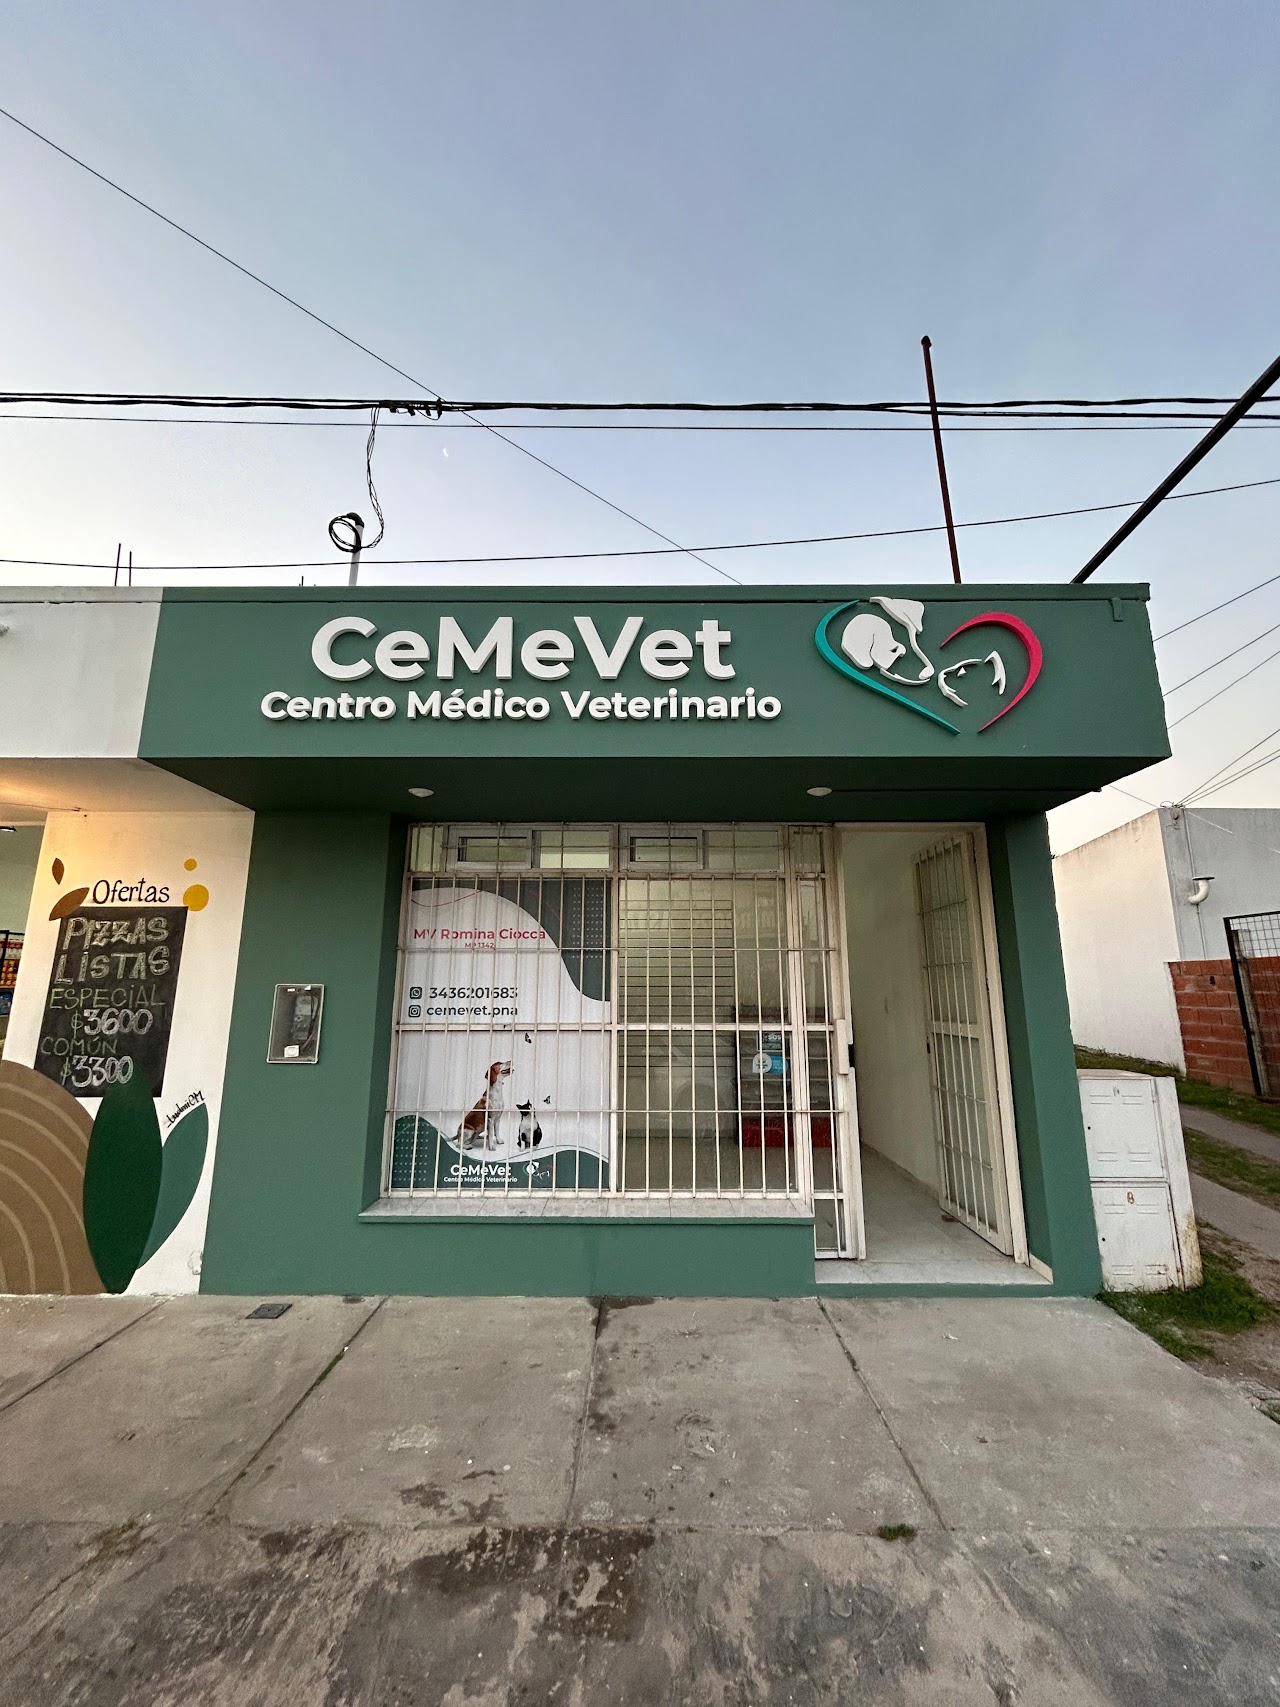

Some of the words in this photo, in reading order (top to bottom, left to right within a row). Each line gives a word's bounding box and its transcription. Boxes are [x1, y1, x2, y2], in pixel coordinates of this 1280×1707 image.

[311, 615, 737, 682] CeMeVet
[260, 690, 397, 721] Centro
[407, 687, 550, 721] Médico
[560, 687, 783, 721] Veterinario
[92, 877, 170, 904] Ofertas
[441, 927, 495, 940] Romina
[499, 927, 546, 940] Ciocca
[429, 987, 518, 999] 3436201683
[71, 1007, 153, 1038] $3600
[40, 1035, 118, 1056] COMÚN
[60, 1054, 134, 1088] $3300
